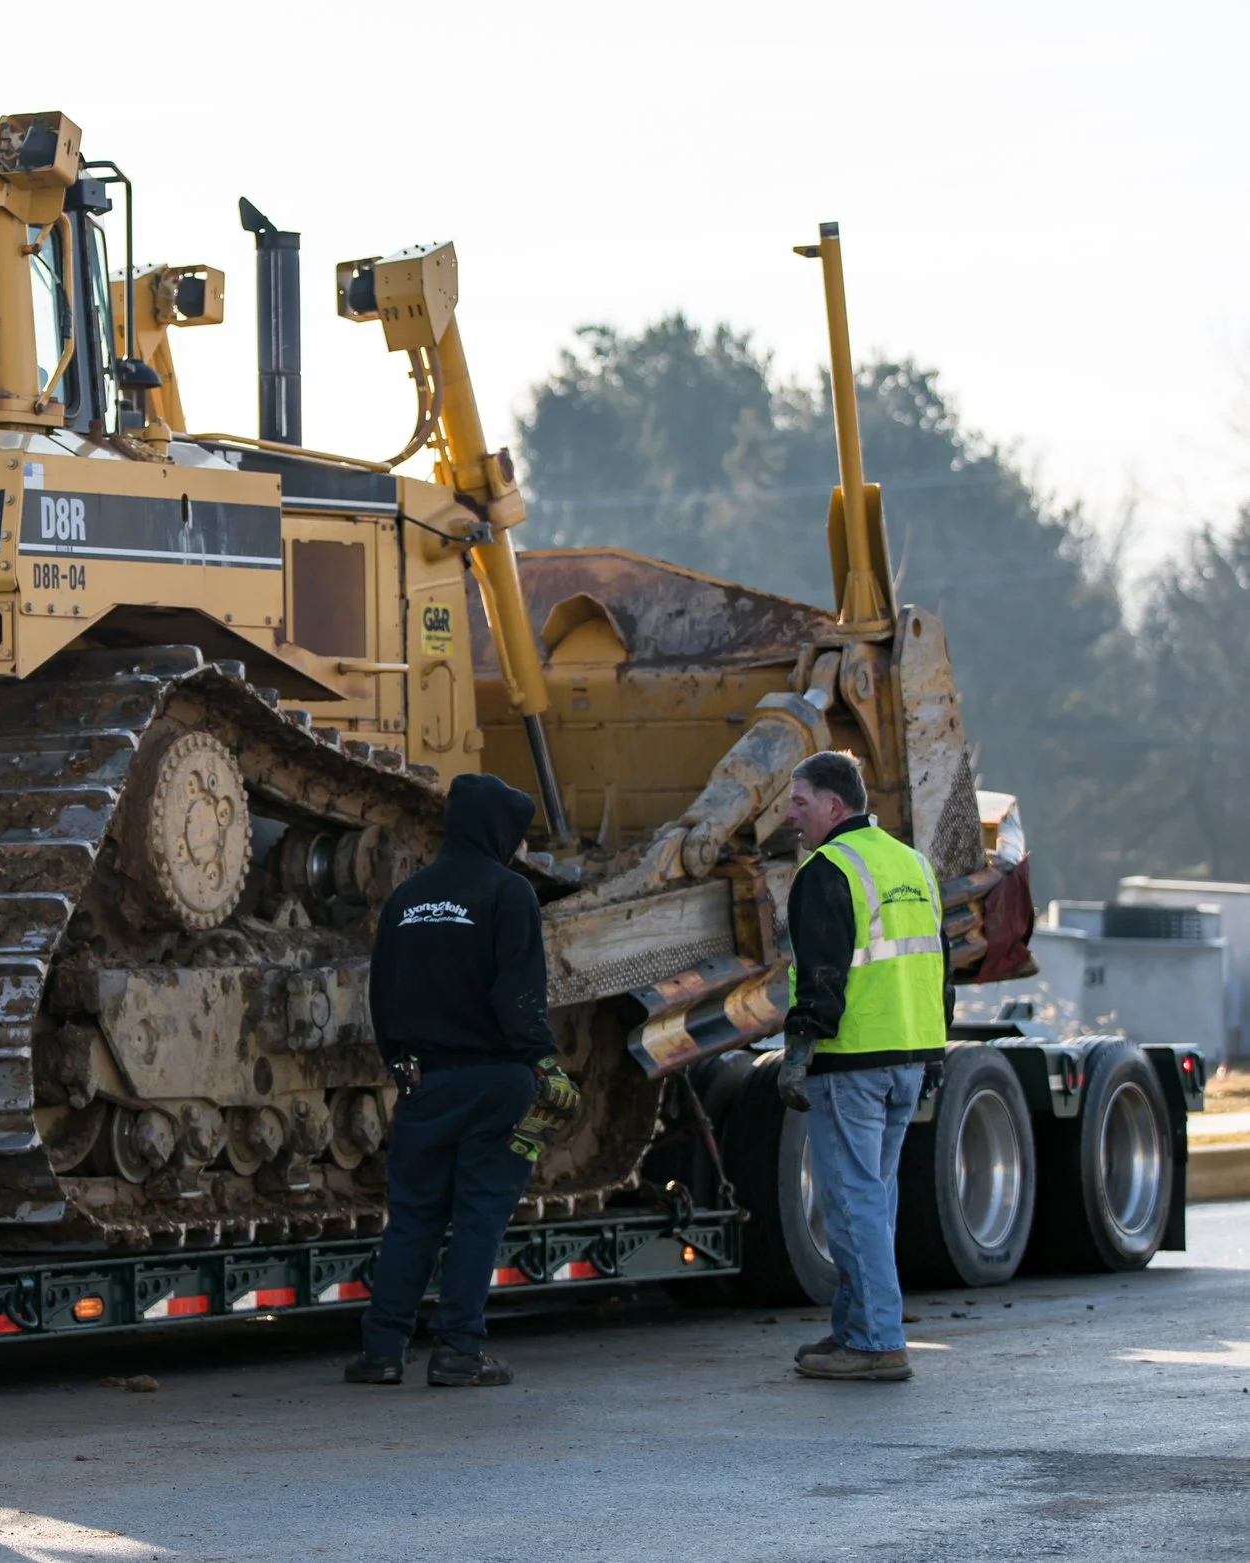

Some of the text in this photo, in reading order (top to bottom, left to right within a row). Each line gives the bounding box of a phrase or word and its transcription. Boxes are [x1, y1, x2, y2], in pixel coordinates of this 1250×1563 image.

[40, 496, 86, 541] D8R
[33, 563, 86, 590] D8R-04
[423, 606, 450, 632] G&R
